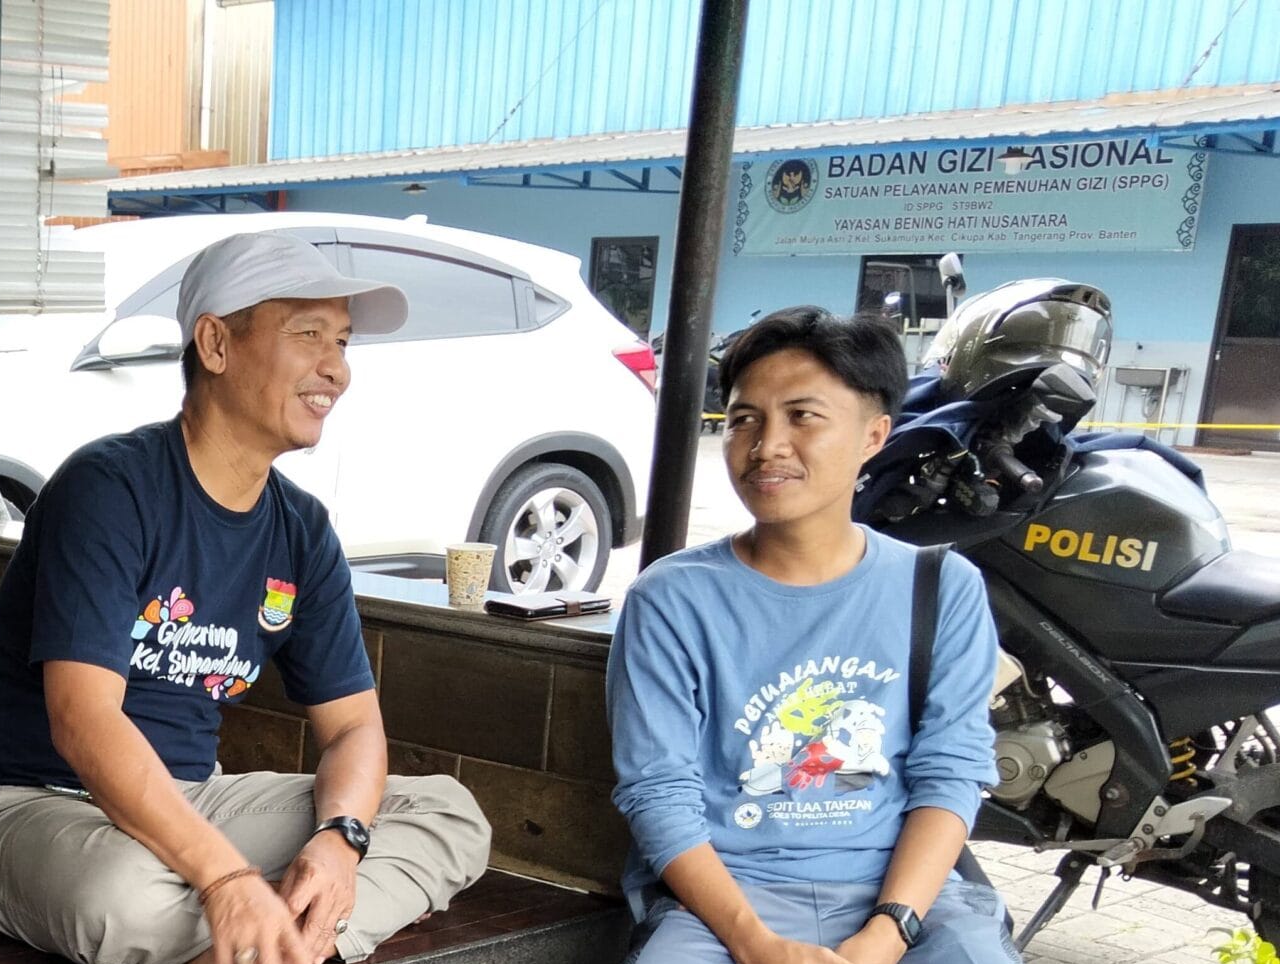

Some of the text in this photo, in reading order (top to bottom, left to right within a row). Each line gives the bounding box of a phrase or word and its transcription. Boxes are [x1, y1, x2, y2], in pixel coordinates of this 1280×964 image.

[827, 139, 1174, 178] BADAN GIZI ASIONAL
[824, 174, 1170, 199] SATUAN PELAYANAN PEMENUHAN GIZI (SPPG)
[903, 203, 915, 211] ID
[916, 202, 944, 211] SPPG
[833, 213, 1068, 231] YAYASAN BENING HATI NUSANTARA
[775, 236, 797, 245] Jalan
[874, 233, 926, 244] Sukamulya
[951, 232, 984, 243] Cikupa
[1013, 230, 1066, 243] Tangerang
[1098, 229, 1137, 240] Banten
[1023, 523, 1159, 572] POLISI
[1038, 621, 1111, 684] DELTABOX
[734, 655, 901, 736] PETUALANGAN
[767, 799, 872, 812] SDIT LAA TAHZAN
